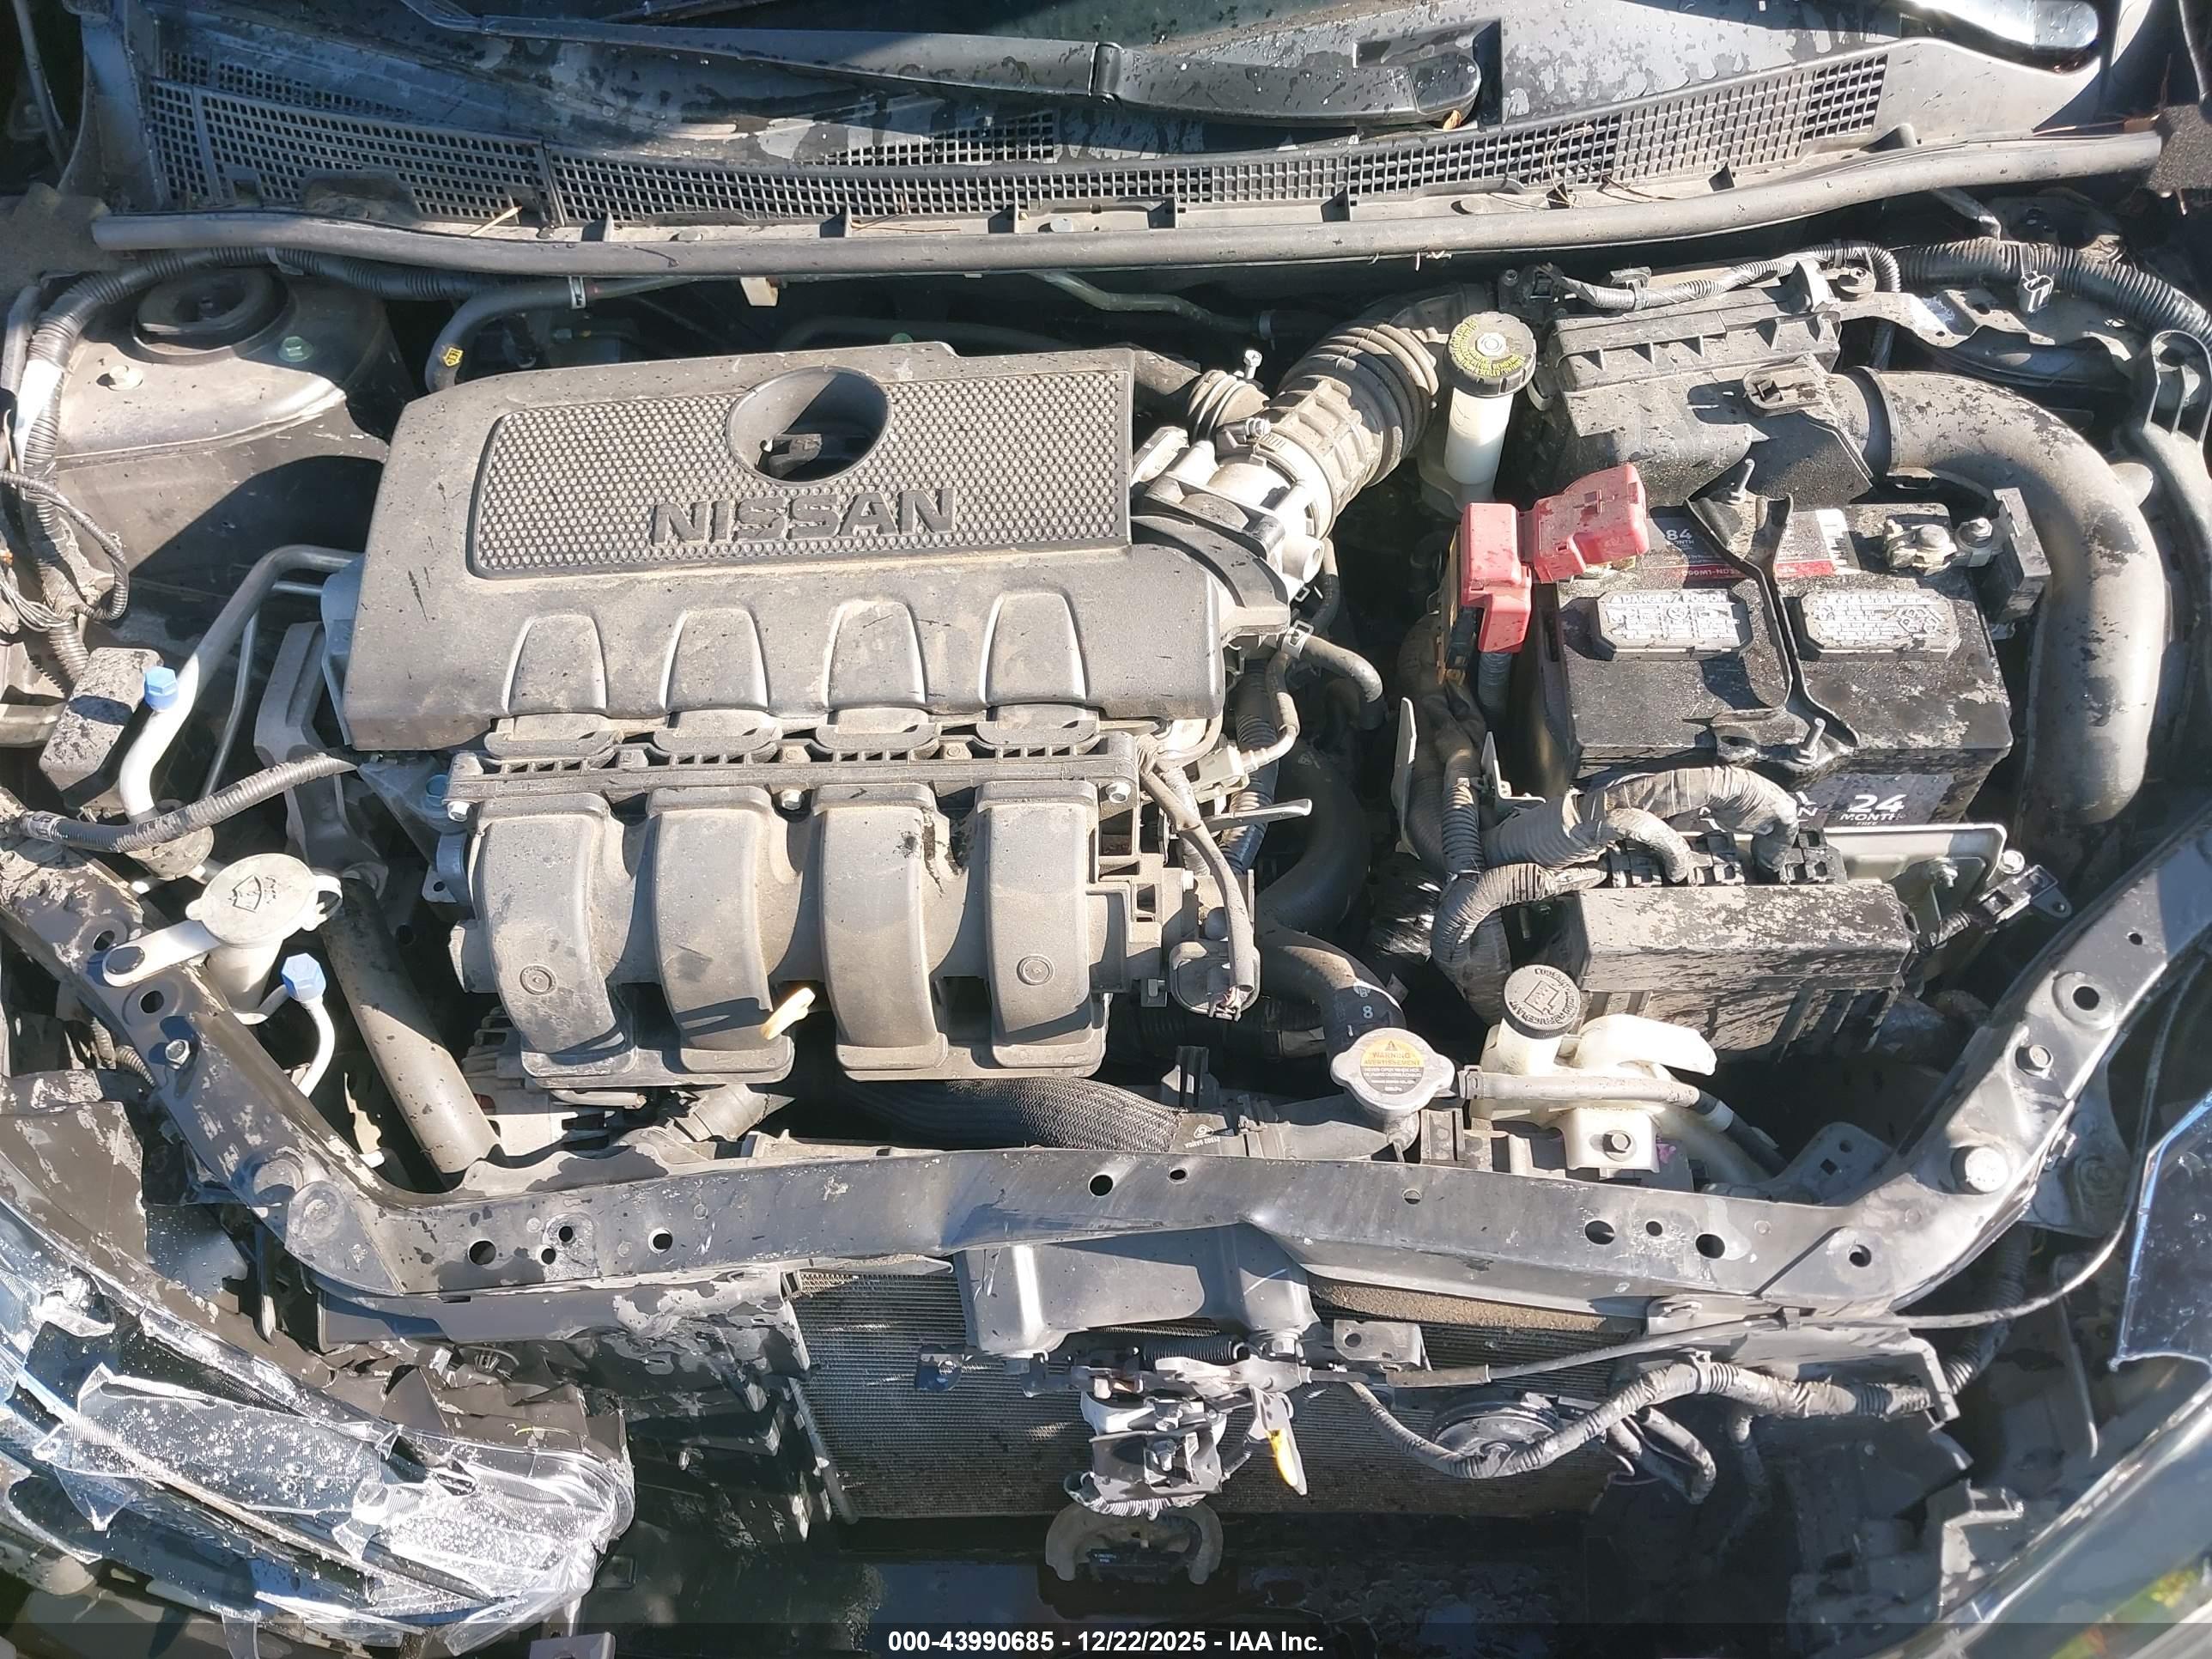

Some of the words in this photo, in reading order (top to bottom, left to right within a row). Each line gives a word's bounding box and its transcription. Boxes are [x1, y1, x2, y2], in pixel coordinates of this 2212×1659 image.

[650, 488, 956, 547] NISSAN
[1666, 528, 1692, 540] 84
[1847, 793, 1907, 813] 24
[1363, 1006, 1373, 1019] 8
